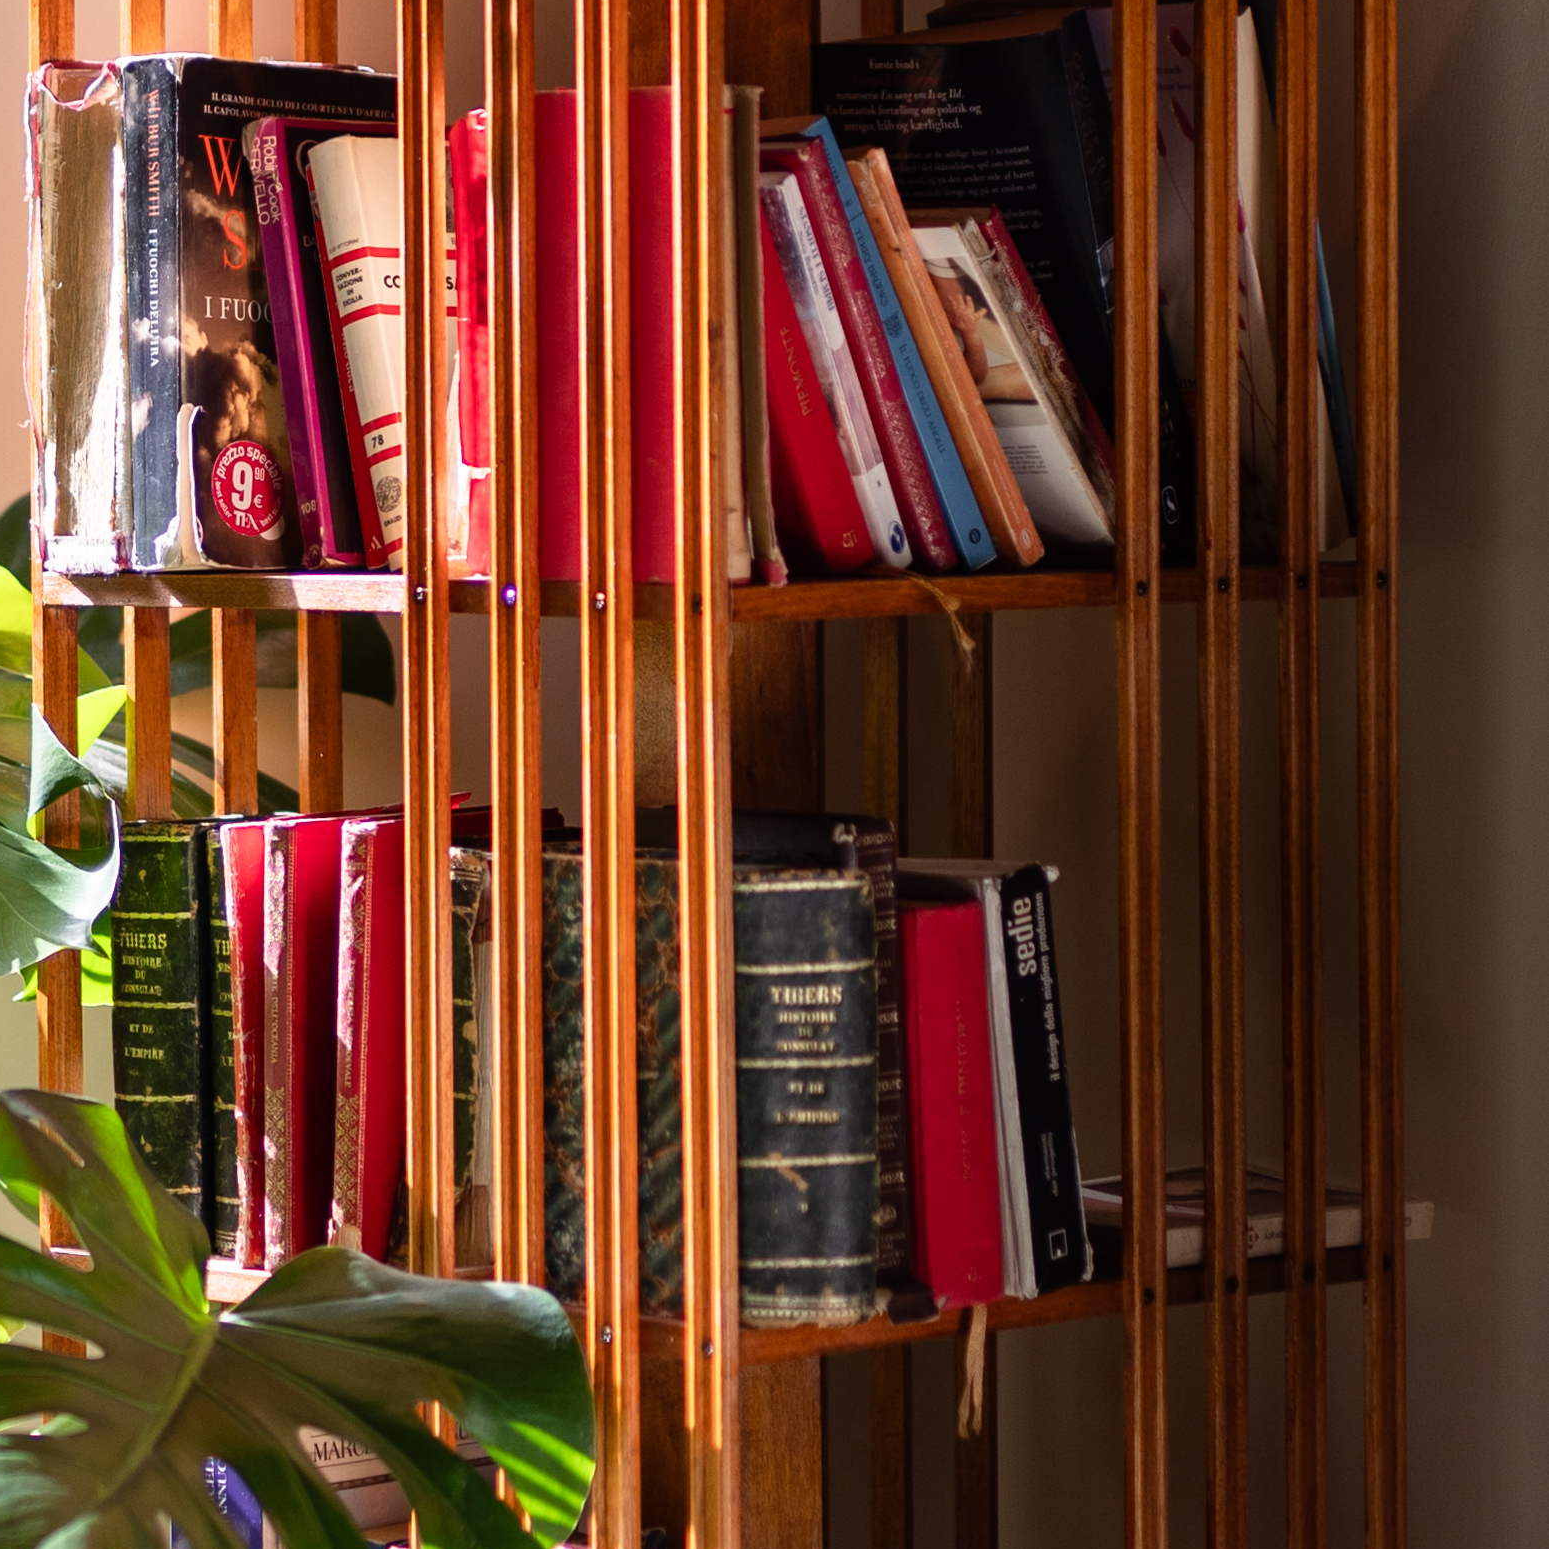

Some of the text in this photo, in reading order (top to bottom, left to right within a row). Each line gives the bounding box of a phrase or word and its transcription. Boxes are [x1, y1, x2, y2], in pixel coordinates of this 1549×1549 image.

[895, 59, 914, 69] bind
[211, 92, 396, 119] IL GRANDE CICLO DEI COURTENEY D'AFRICA
[881, 90, 893, 99] En
[894, 92, 913, 102] sang
[937, 92, 947, 102] og
[204, 104, 267, 119] IL CAPOLAVORO
[838, 105, 876, 115] fantastisk
[878, 105, 919, 117] fortælling
[921, 107, 936, 115] om
[937, 103, 968, 117] politik
[969, 104, 982, 115] og
[877, 119, 895, 131] håb
[897, 122, 909, 133] og
[910, 118, 963, 132] kærlighed.
[147, 89, 161, 217] WILBUR SMITH
[251, 137, 270, 225] CERVELLO
[262, 135, 281, 223] Robin Cook
[149, 240, 159, 296] FUOCHI
[335, 267, 363, 282] CONVER-
[853, 225, 872, 264] TERRY
[867, 264, 891, 308] BROOKS
[338, 276, 363, 291] SAZIONE
[347, 288, 355, 296] IN
[816, 270, 836, 312] SEMPRE
[204, 296, 273, 323] I FUOC
[342, 294, 363, 308] SICILIA
[780, 327, 812, 417] PIEMONTE
[899, 343, 946, 454] IL FUOCO DEGLI ANGELI
[371, 434, 384, 449] 78
[216, 445, 282, 491] prezzo speciale
[231, 461, 253, 510] 9
[254, 466, 265, 482] 90
[301, 499, 317, 515] 108
[1035, 892, 1050, 952] produzione
[119, 933, 167, 949] THIERS
[1008, 896, 1037, 977] sedie
[122, 956, 162, 968] HISTOIRE
[135, 970, 146, 980] DU
[1040, 954, 1055, 999] migliore
[770, 985, 844, 1005] THIERS
[777, 1011, 837, 1024] HISTOIRE
[1045, 1001, 1056, 1029] della
[130, 1024, 154, 1034] ET DE
[125, 1047, 164, 1060] L'EMPIRE
[1048, 1031, 1060, 1069] design
